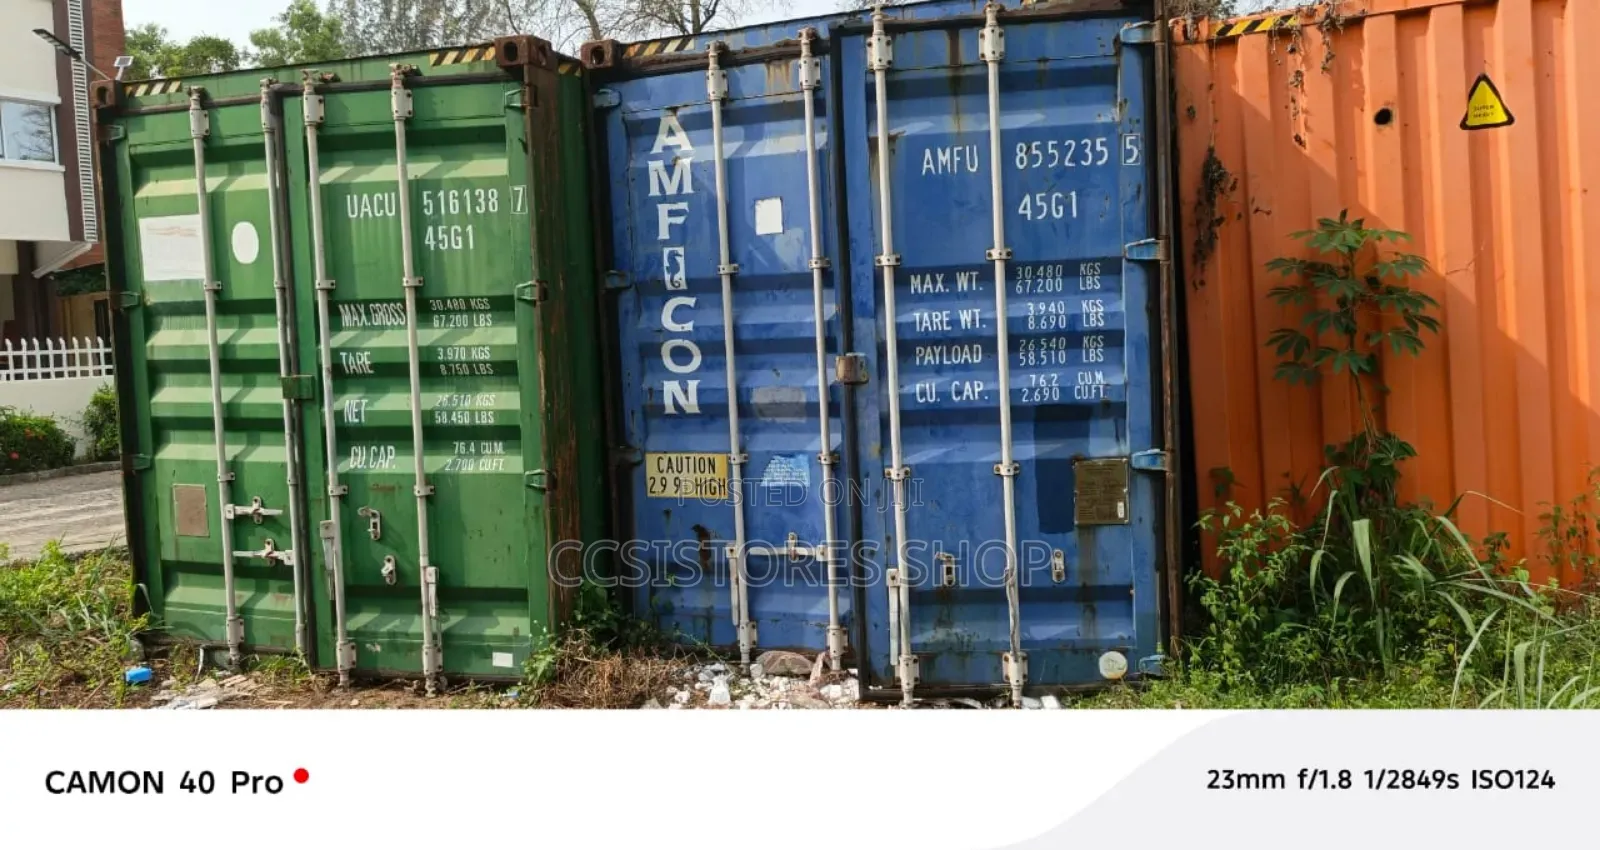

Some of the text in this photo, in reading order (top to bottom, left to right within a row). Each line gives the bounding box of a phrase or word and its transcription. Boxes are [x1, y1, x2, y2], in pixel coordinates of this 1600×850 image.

[922, 135, 1139, 176] AMFU 855235 5
[347, 186, 525, 218] UACU 516138 7
[1018, 190, 1077, 220] 45G1
[424, 224, 474, 250] 45G1
[1016, 262, 1101, 280] 30.480 KGS
[910, 271, 984, 294] MAX. WT.
[1015, 276, 1101, 294] 67.200 LBS
[430, 298, 491, 311] 30.480 KGS
[1028, 299, 1104, 316] 3.940 KGS
[433, 313, 492, 328] 67.200 LBS
[914, 309, 987, 332] TARE WT.
[1028, 313, 1105, 329] 8.690 LBS
[437, 346, 491, 360] 3.970 KGS
[1020, 336, 1104, 352] 26.540 KGS
[340, 351, 375, 375] TARE
[915, 344, 982, 365] PAYLOAD
[1020, 349, 1104, 366] 58.510 LBS
[440, 363, 494, 376] 8.750 LBS
[1029, 373, 1059, 387] 76.2
[475, 394, 496, 407] KGS
[915, 380, 988, 403] CU. CAP.
[1022, 387, 1060, 402] 2.690
[344, 399, 369, 424] NET
[434, 411, 495, 424] 58.450 LBS
[453, 441, 476, 455] 76.4
[657, 456, 716, 474] CAUTION
[695, 477, 726, 496] HIGH
